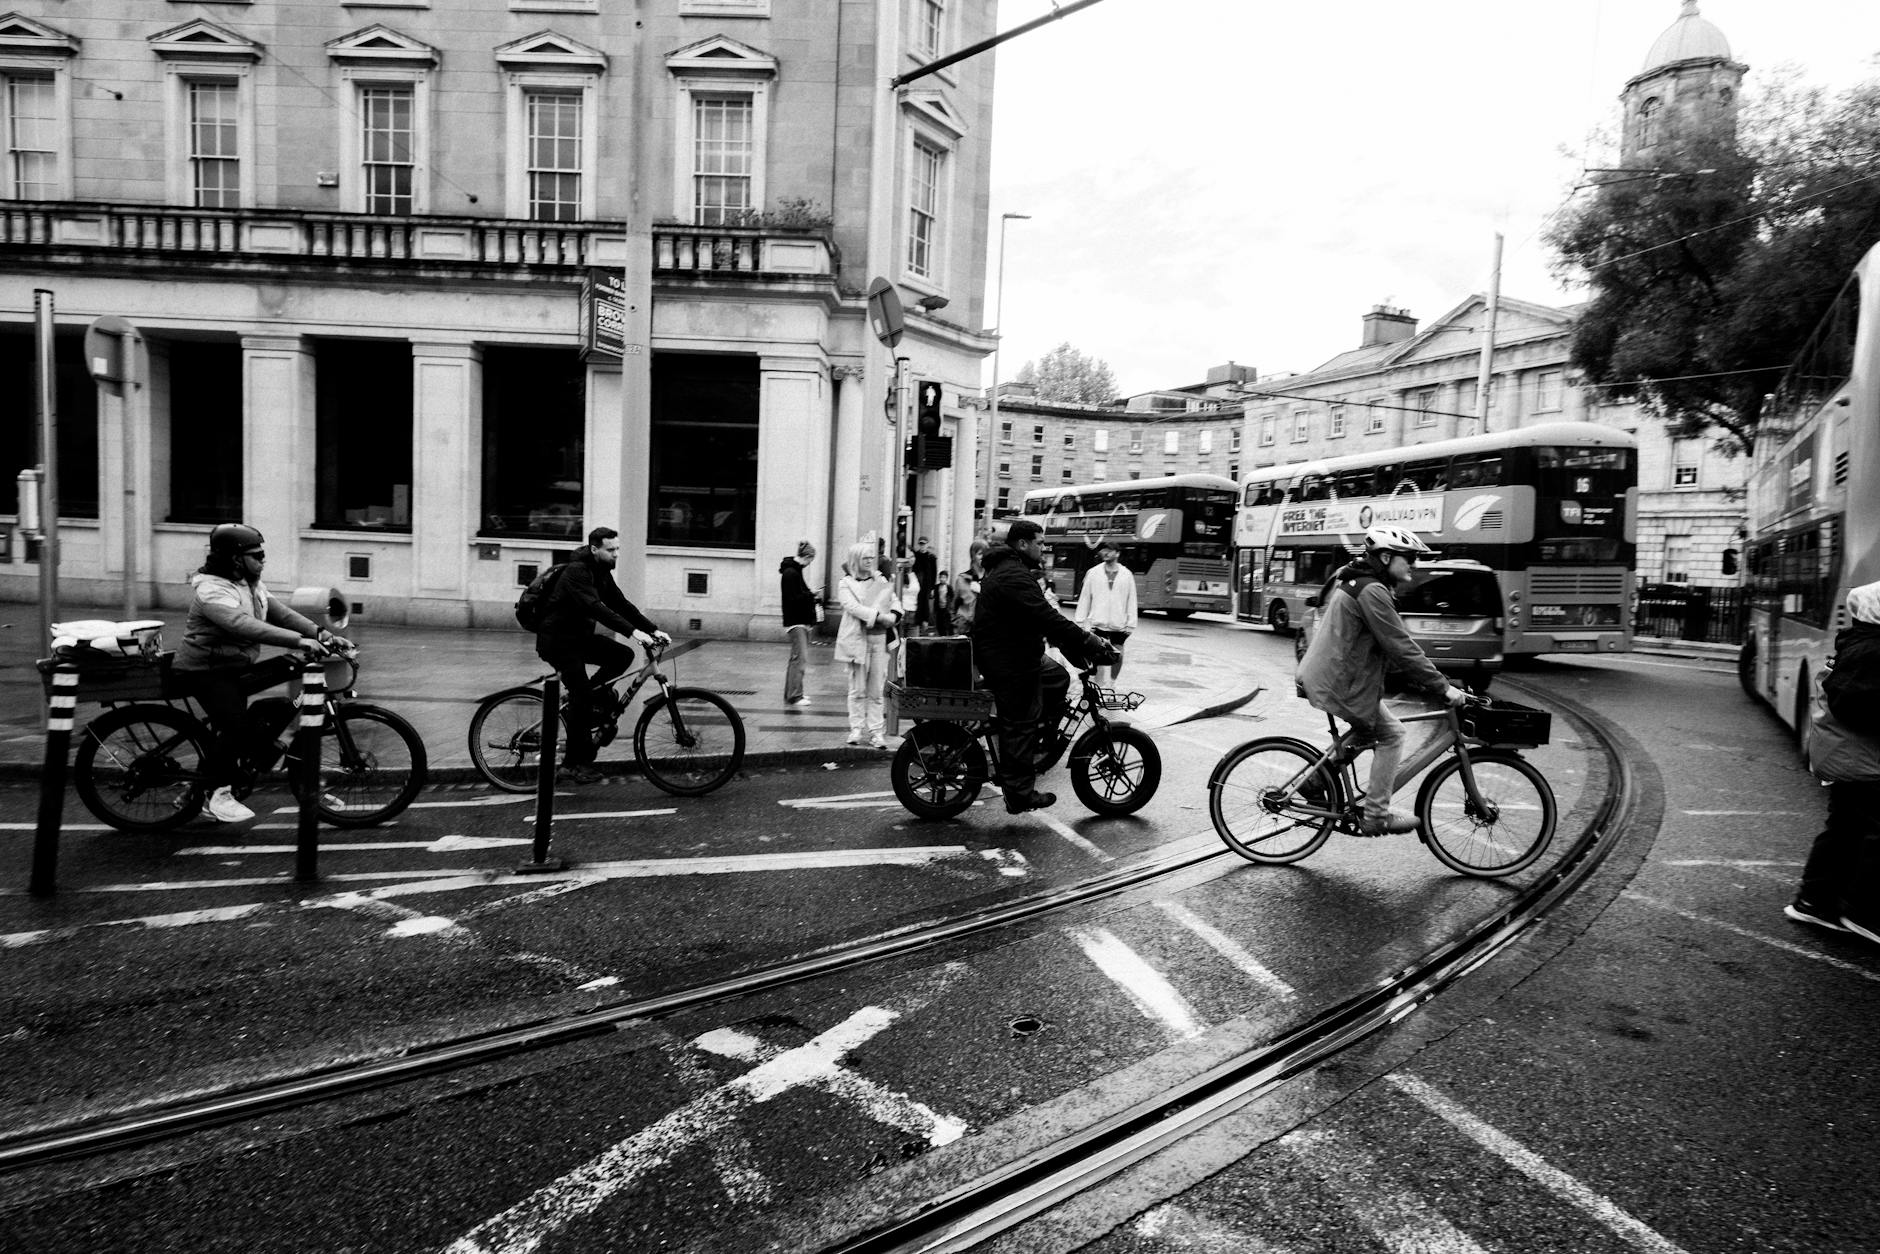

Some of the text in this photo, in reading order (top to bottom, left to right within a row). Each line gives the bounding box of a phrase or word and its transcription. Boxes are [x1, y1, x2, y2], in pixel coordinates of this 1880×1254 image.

[608, 276, 620, 289] TO
[597, 316, 626, 332] CORR
[1282, 507, 1327, 521] FREE THE
[1418, 507, 1437, 520] VPN
[1282, 520, 1325, 532] INTERNET
